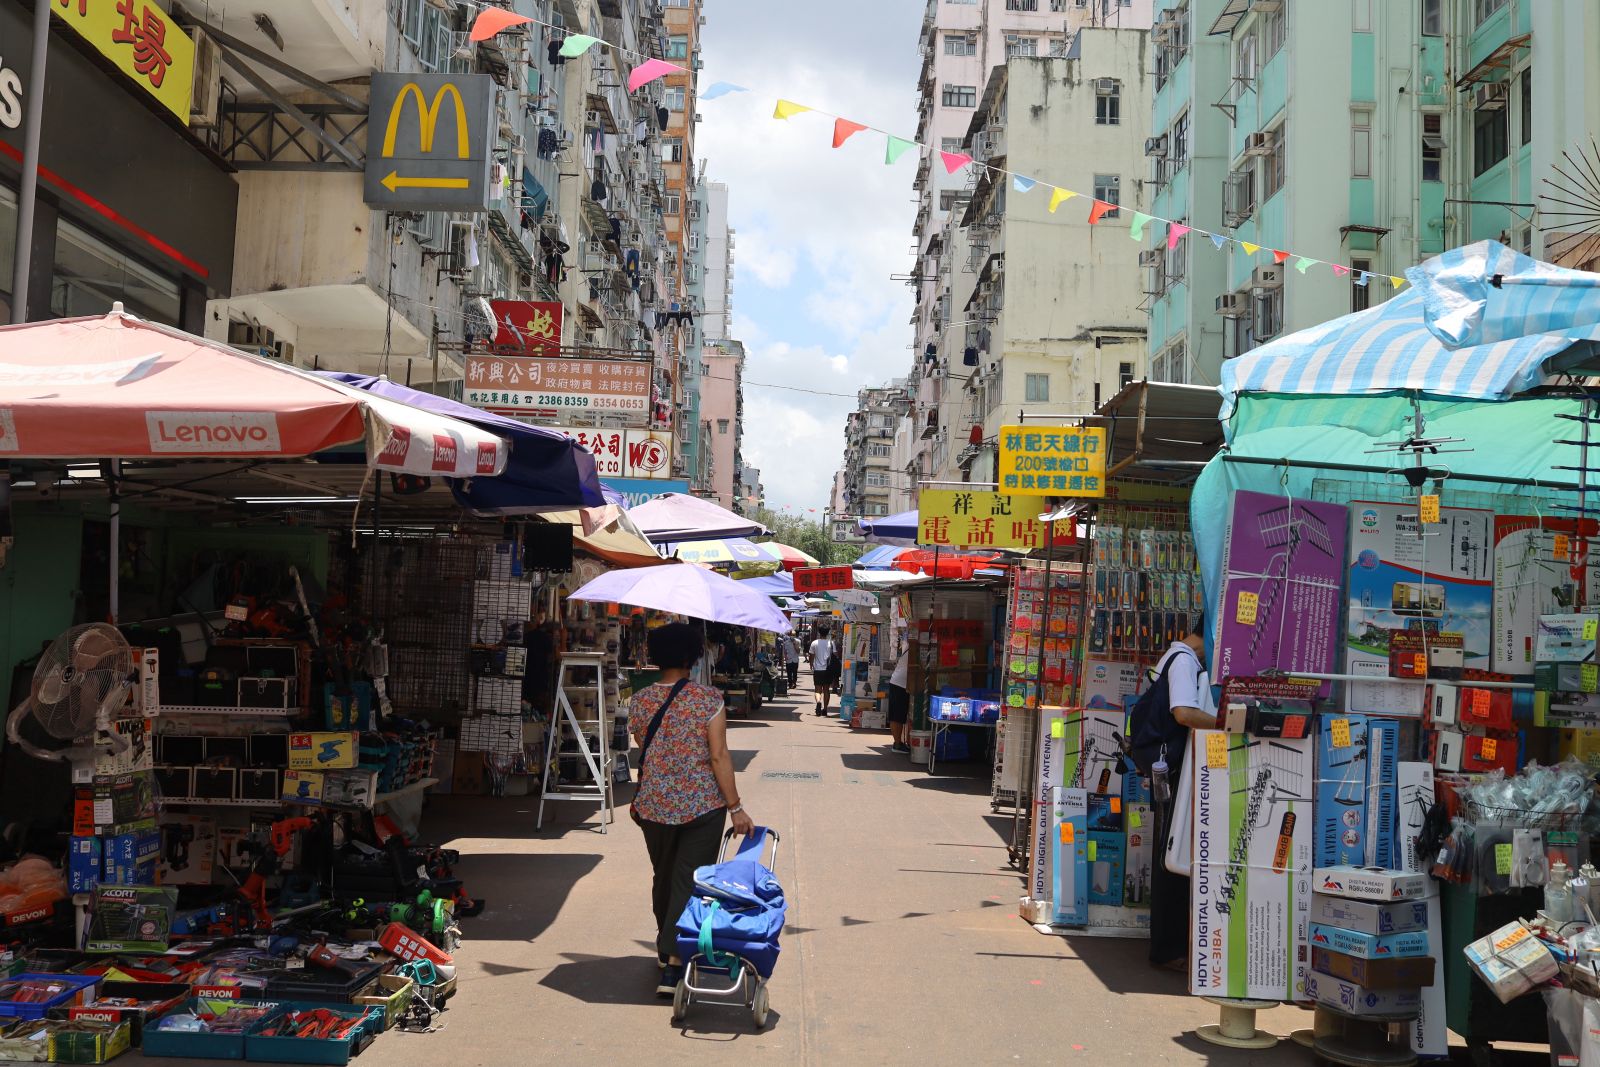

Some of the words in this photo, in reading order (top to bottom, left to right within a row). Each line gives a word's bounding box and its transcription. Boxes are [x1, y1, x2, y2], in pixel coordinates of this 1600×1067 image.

[469, 361, 543, 385] 新興公司
[545, 377, 593, 390] 政府物資
[598, 381, 646, 393] 法院封存
[538, 395, 562, 405] 2386
[564, 396, 589, 407] 8359
[593, 397, 618, 407] 6354
[620, 398, 644, 409] 0653
[158, 420, 268, 442] Lenovo
[1006, 434, 1099, 453] 林記天線行
[436, 441, 455, 462] Lenovo
[953, 493, 1011, 515] 祥記
[923, 516, 1039, 546] 電話咭
[1222, 647, 1231, 679] WC-63
[1043, 734, 1052, 779] ANTENNA
[1041, 781, 1049, 822] OUTDOOR
[1200, 765, 1210, 826] ANTENNA
[1284, 814, 1295, 835] GAIN
[1325, 818, 1337, 856] ANTENNA
[1038, 823, 1047, 866] DIGITAL
[1200, 830, 1209, 895] OUTDOOR
[1036, 868, 1044, 894] HDTV
[12, 909, 46, 922] DEVON
[1199, 899, 1208, 947] DIGITAL
[1198, 952, 1207, 988] HDTV
[1212, 928, 1221, 988] WC-318A
[198, 989, 233, 998] DEVON
[76, 1013, 112, 1021] DEVON
